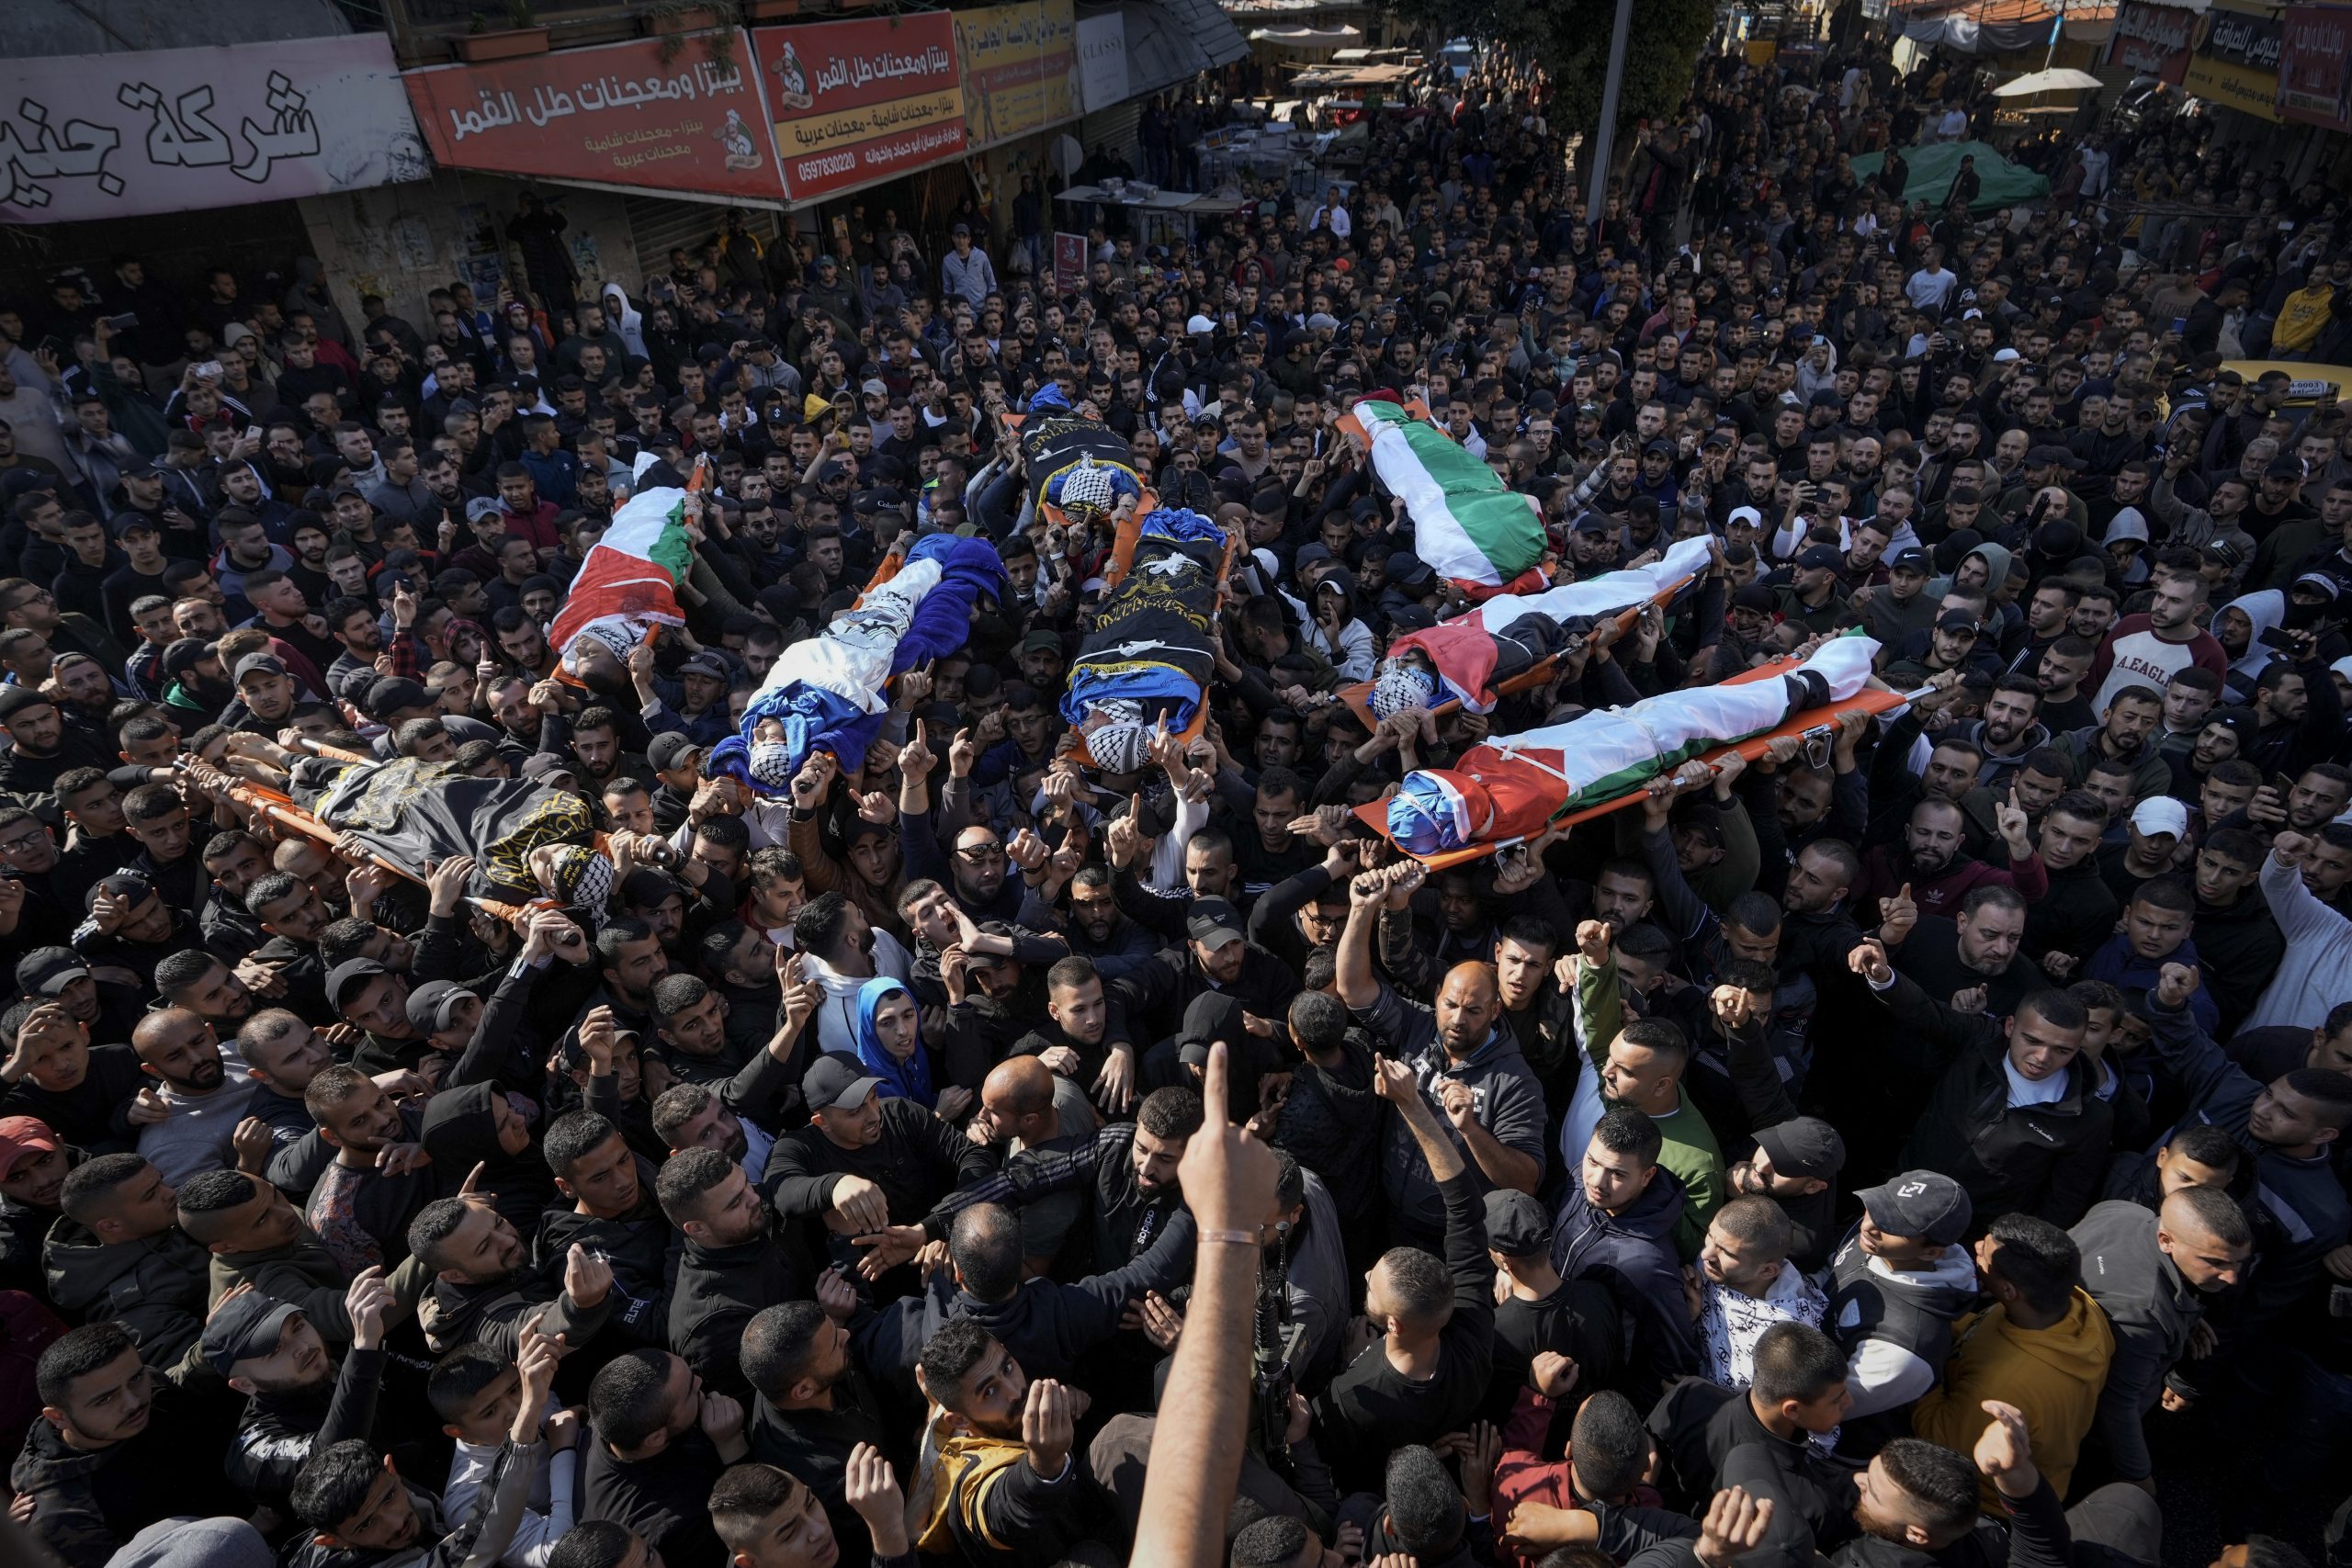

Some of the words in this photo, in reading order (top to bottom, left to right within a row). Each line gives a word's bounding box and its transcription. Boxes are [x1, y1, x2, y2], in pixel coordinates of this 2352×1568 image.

[873, 52, 928, 81] ومعجنات
[927, 44, 950, 73] بيتزا
[695, 61, 742, 96] بيتزا
[816, 57, 849, 95] القمر
[850, 57, 873, 88] طل
[578, 74, 695, 111] ومعجنات
[450, 90, 522, 141] القمر
[526, 87, 575, 127] طل
[872, 104, 899, 126] شامية
[900, 104, 933, 121] معجنات
[939, 96, 955, 115] بيتزا
[118, 70, 321, 184] شركة
[625, 127, 673, 144] معجنات
[681, 118, 704, 136] بيتزا
[796, 125, 825, 147] عربية
[826, 120, 865, 138] معجنات
[583, 130, 624, 153] شامية
[645, 144, 692, 161] معجنات
[893, 141, 911, 157] حماد
[922, 130, 943, 152] فرسان
[613, 152, 645, 169] عربية
[797, 152, 855, 182] 0597830220
[1137, 1208, 1155, 1245] adidas
